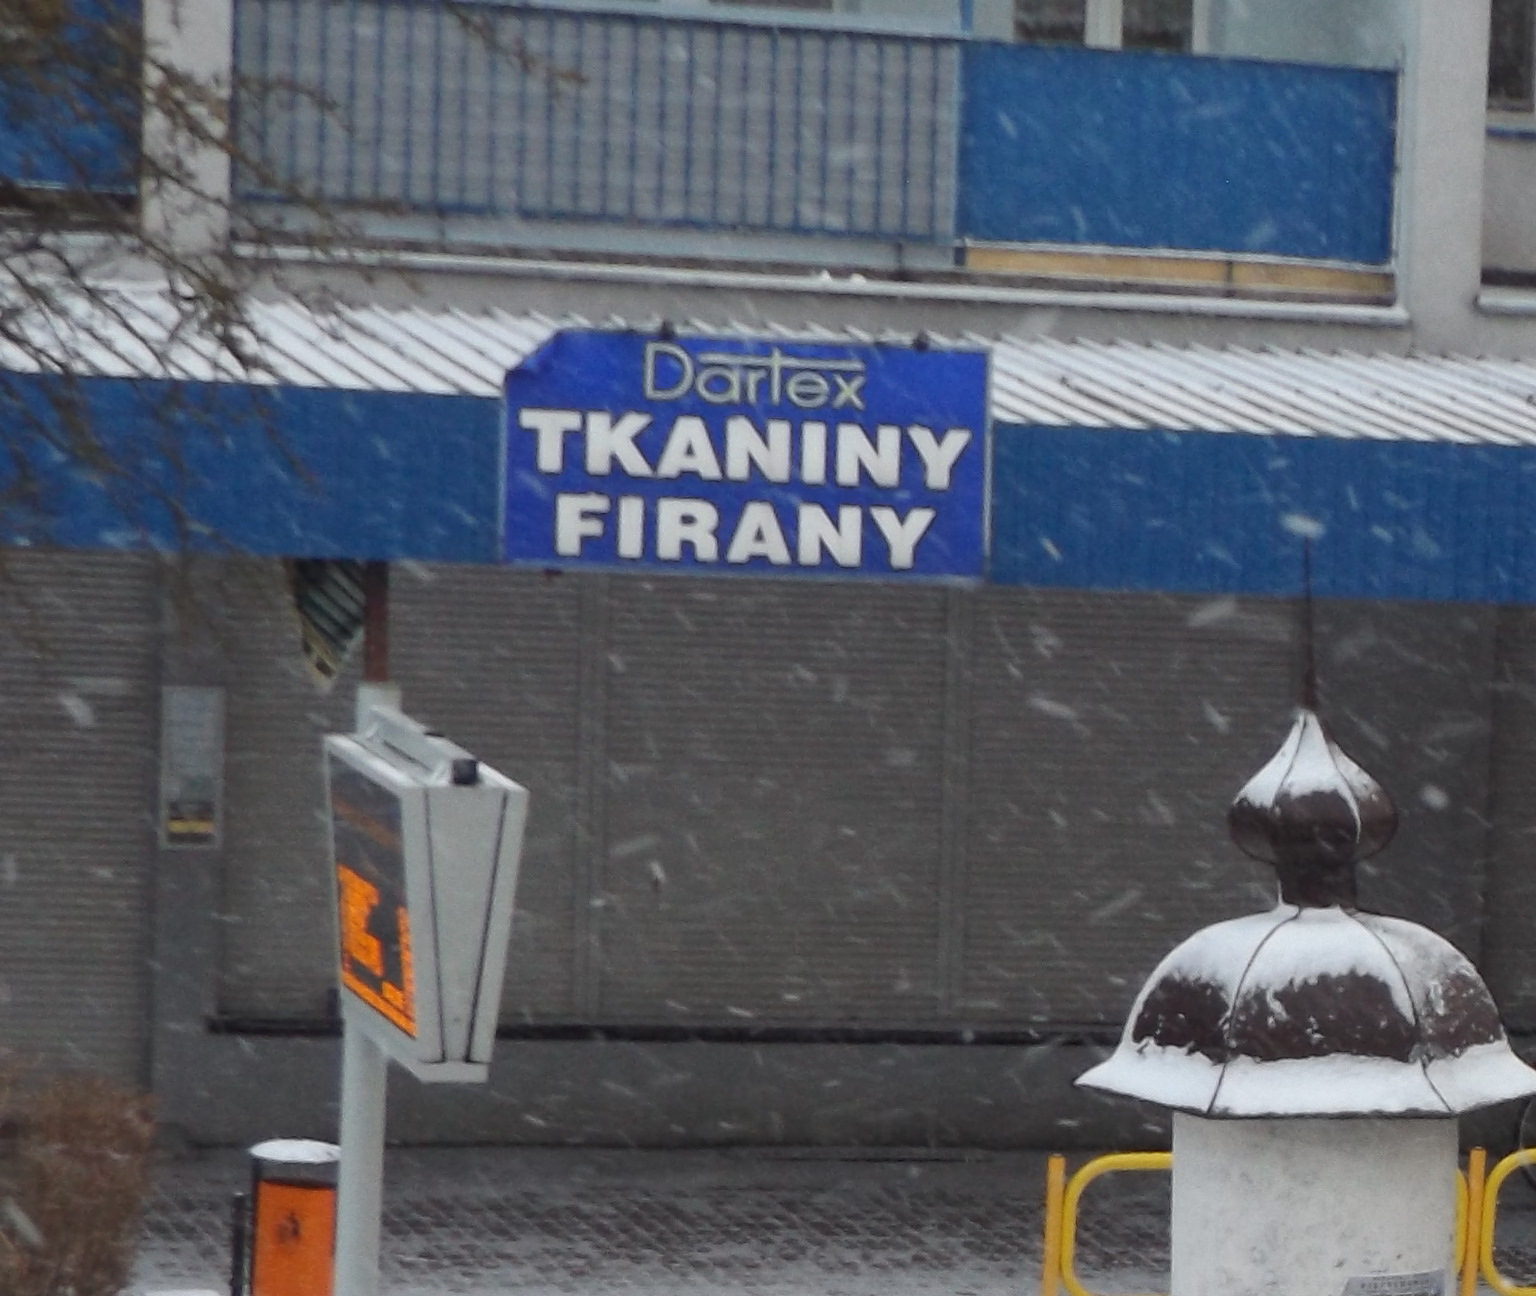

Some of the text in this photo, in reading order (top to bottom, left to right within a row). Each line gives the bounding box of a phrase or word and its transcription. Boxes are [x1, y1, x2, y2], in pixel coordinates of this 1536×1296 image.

[641, 339, 866, 411] Dartex
[517, 407, 973, 491] TKANINY
[554, 491, 937, 571] FIRANY
